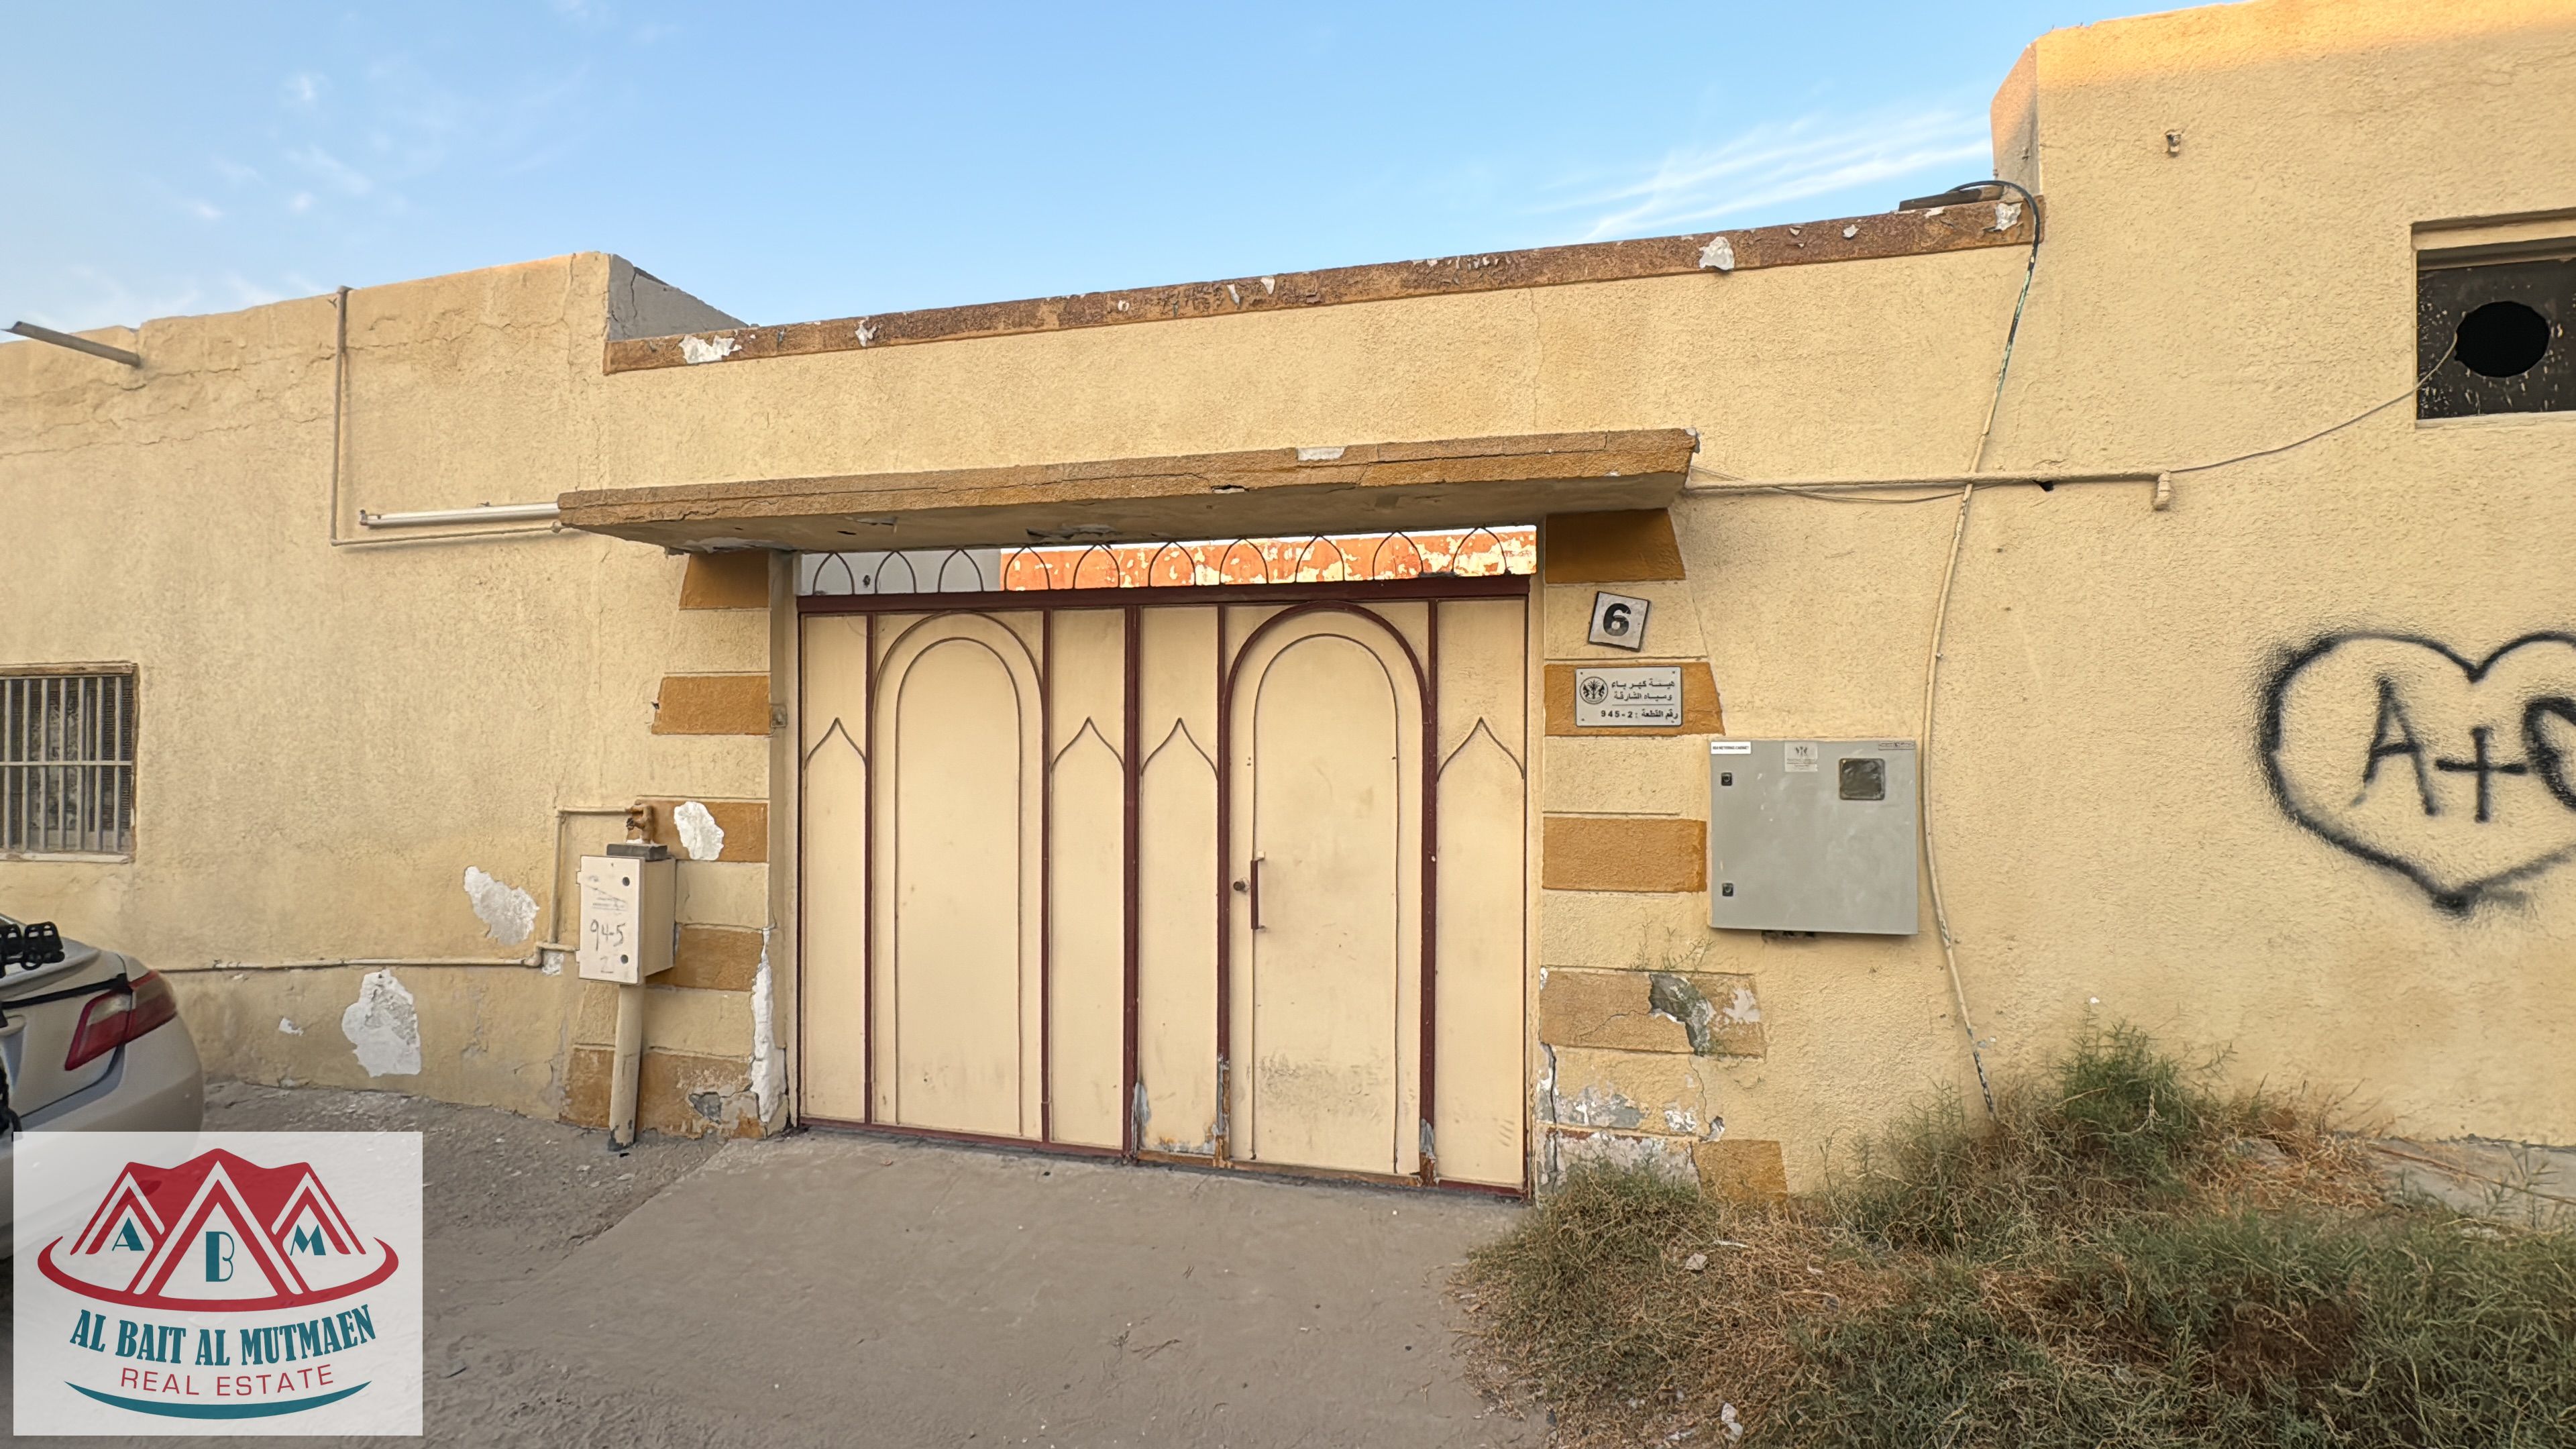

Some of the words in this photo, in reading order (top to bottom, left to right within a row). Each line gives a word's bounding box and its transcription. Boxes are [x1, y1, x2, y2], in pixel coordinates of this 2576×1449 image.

[1603, 603, 1631, 636] 6
[1614, 690, 1642, 702] الشارقة
[1665, 708, 1678, 720] رقم
